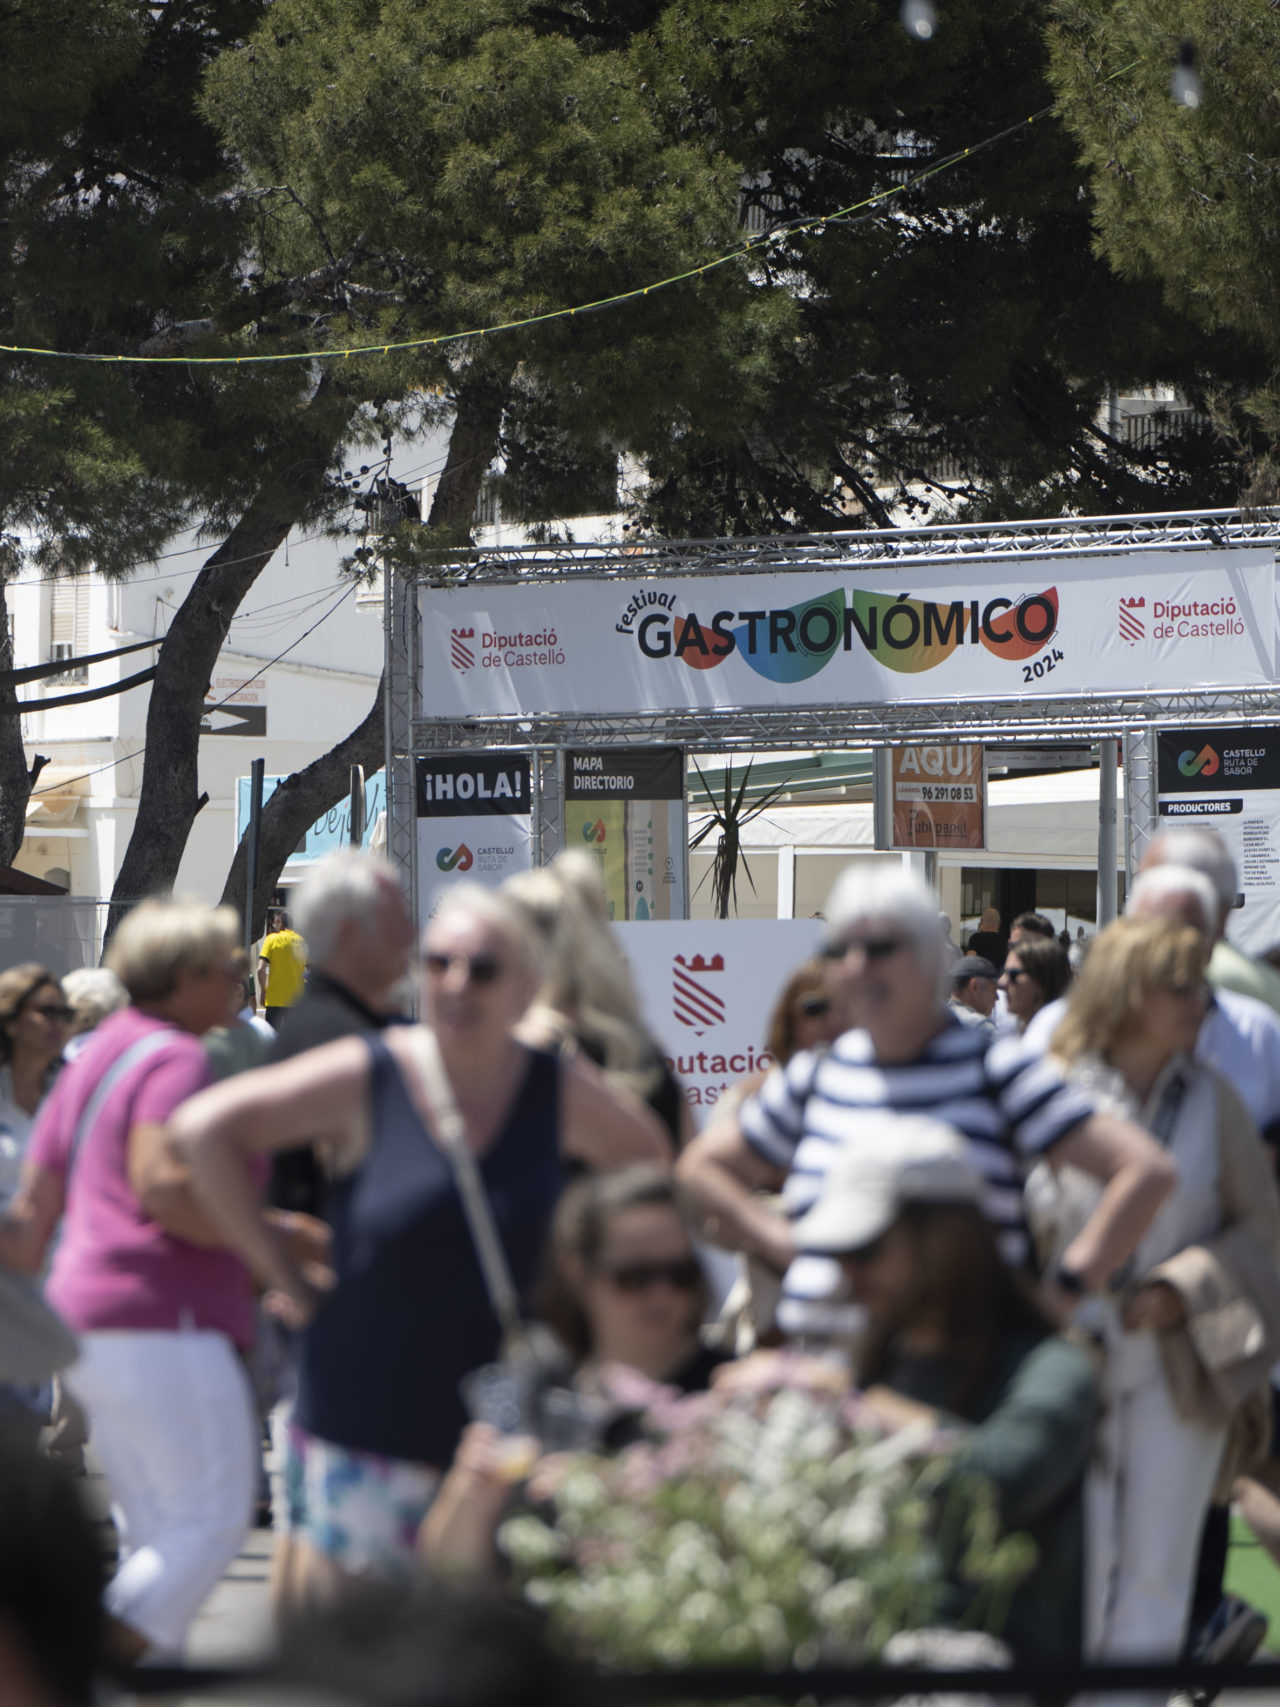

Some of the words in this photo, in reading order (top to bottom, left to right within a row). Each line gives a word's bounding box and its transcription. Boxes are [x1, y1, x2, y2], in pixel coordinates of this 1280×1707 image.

[1153, 597, 1236, 621] Diputació
[637, 593, 1056, 660] GASTRONÓMICO
[1153, 621, 1175, 639] de
[1177, 617, 1245, 638] Castelló
[482, 628, 557, 651] Diputació
[482, 651, 502, 668] de
[504, 648, 566, 667] Castelló
[1022, 647, 1064, 683] 2024
[573, 757, 603, 771] MAPA
[1223, 758, 1246, 767] RUTA
[1248, 758, 1258, 766] DE
[1223, 767, 1253, 776] SABOR
[425, 770, 522, 801] ¡HOLA!
[573, 775, 635, 790] DIRECTORIO
[922, 787, 933, 800] 96
[935, 787, 949, 800] 291
[951, 788, 962, 800] 08
[964, 788, 974, 800] 53
[1168, 802, 1232, 813] PRODUCTORES
[477, 855, 496, 864] RUTA
[498, 855, 507, 863] DE
[477, 863, 503, 871] SABOR
